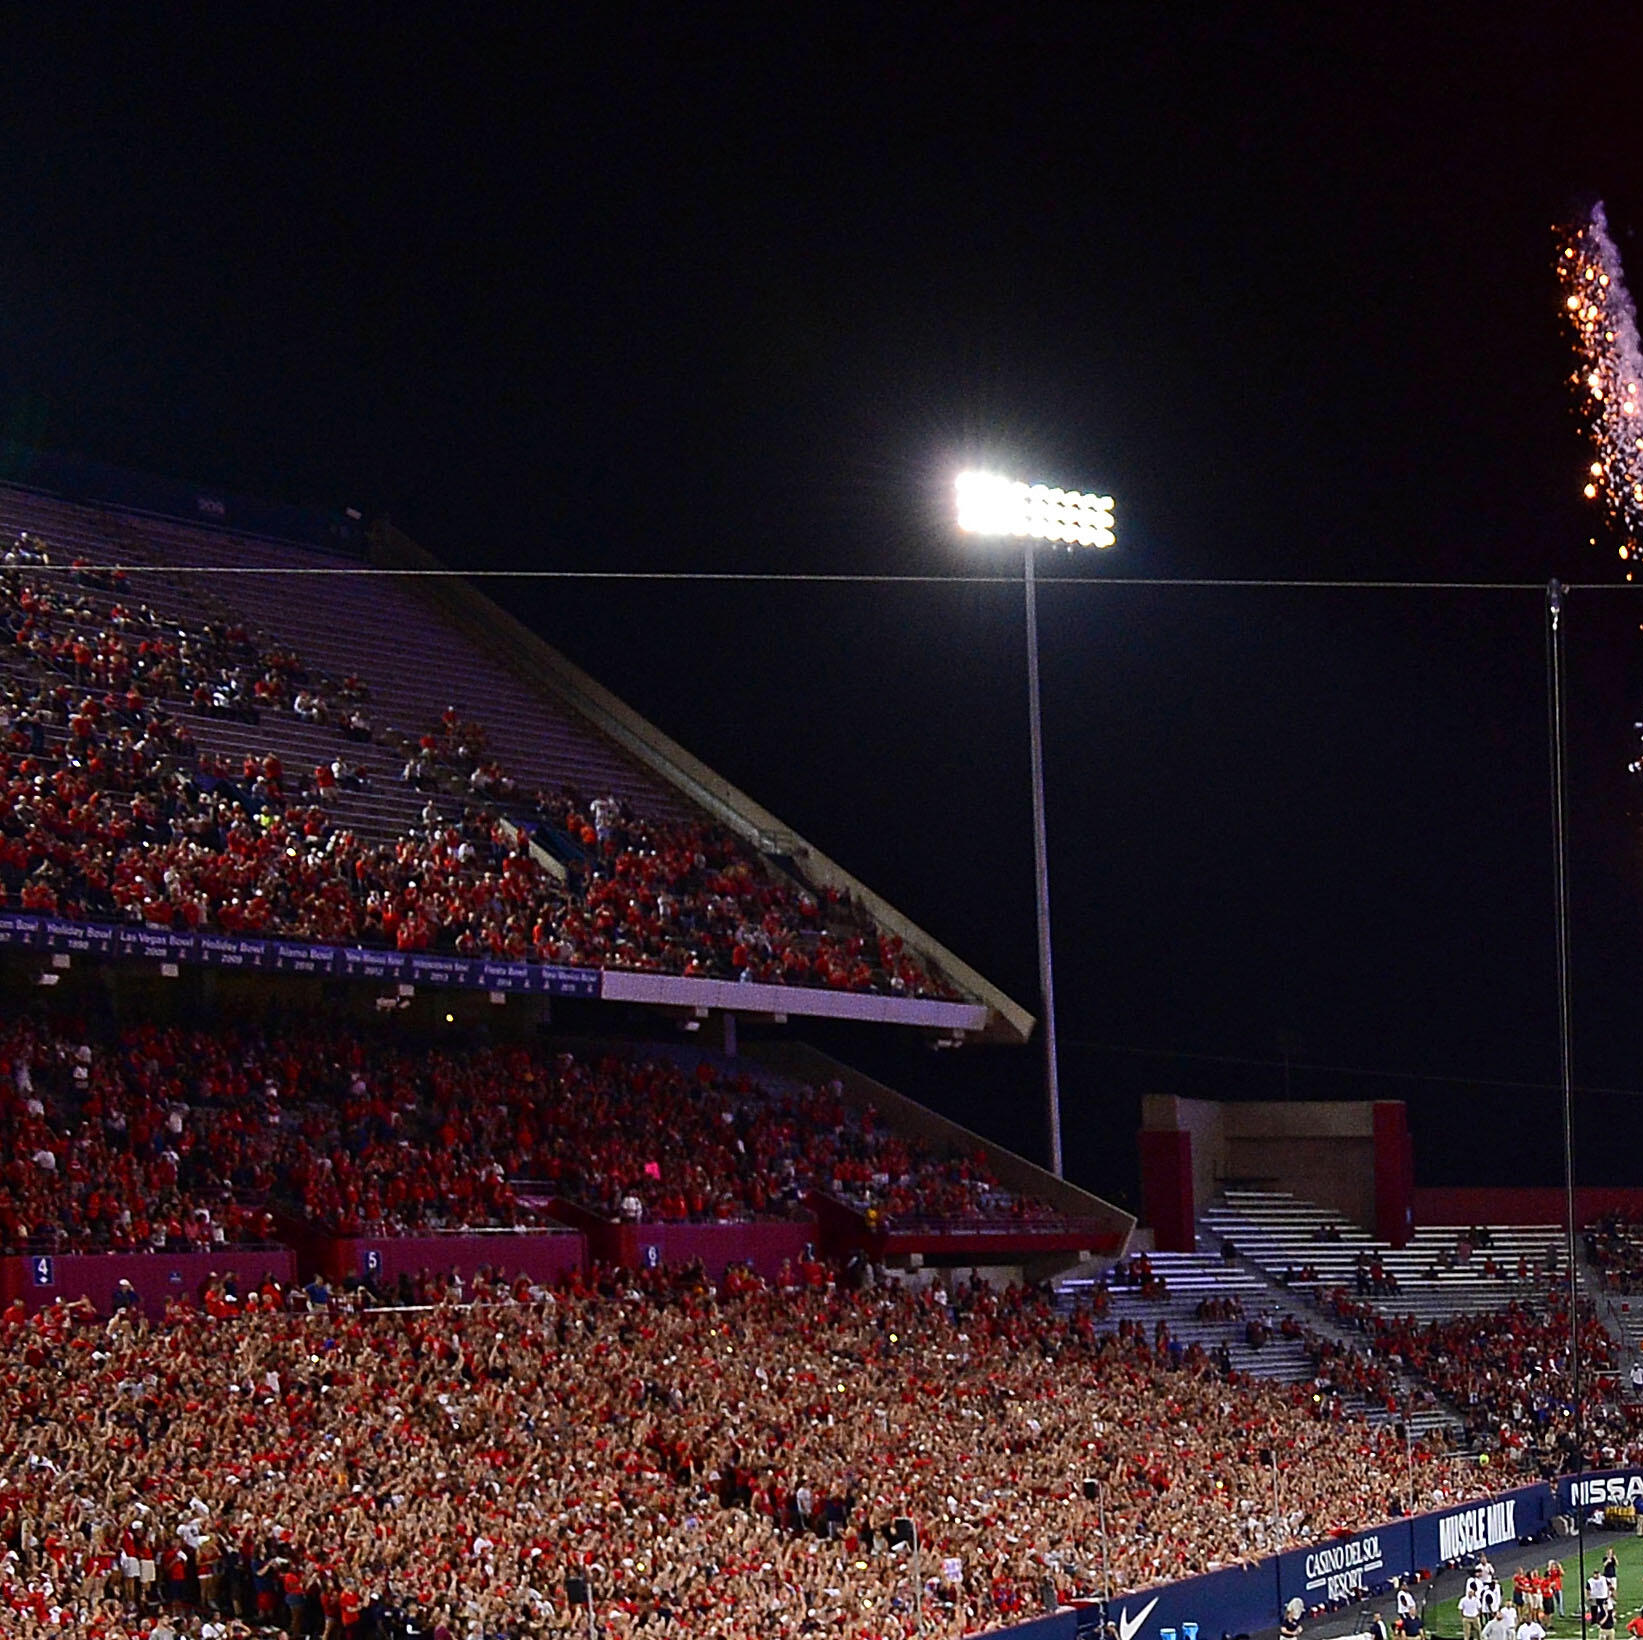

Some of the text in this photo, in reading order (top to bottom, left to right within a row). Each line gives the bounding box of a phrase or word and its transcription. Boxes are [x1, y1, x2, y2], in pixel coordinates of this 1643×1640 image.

[47, 923, 112, 940] Holiday Bowl
[120, 930, 194, 948] Las Vegas Bowl
[201, 938, 265, 955] Holiday Bowl
[37, 1257, 48, 1277] 4
[368, 1254, 378, 1275] 5
[1440, 1499, 1517, 1561] MUSCLE MILK
[1305, 1535, 1382, 1580] CASINO DEL SOL
